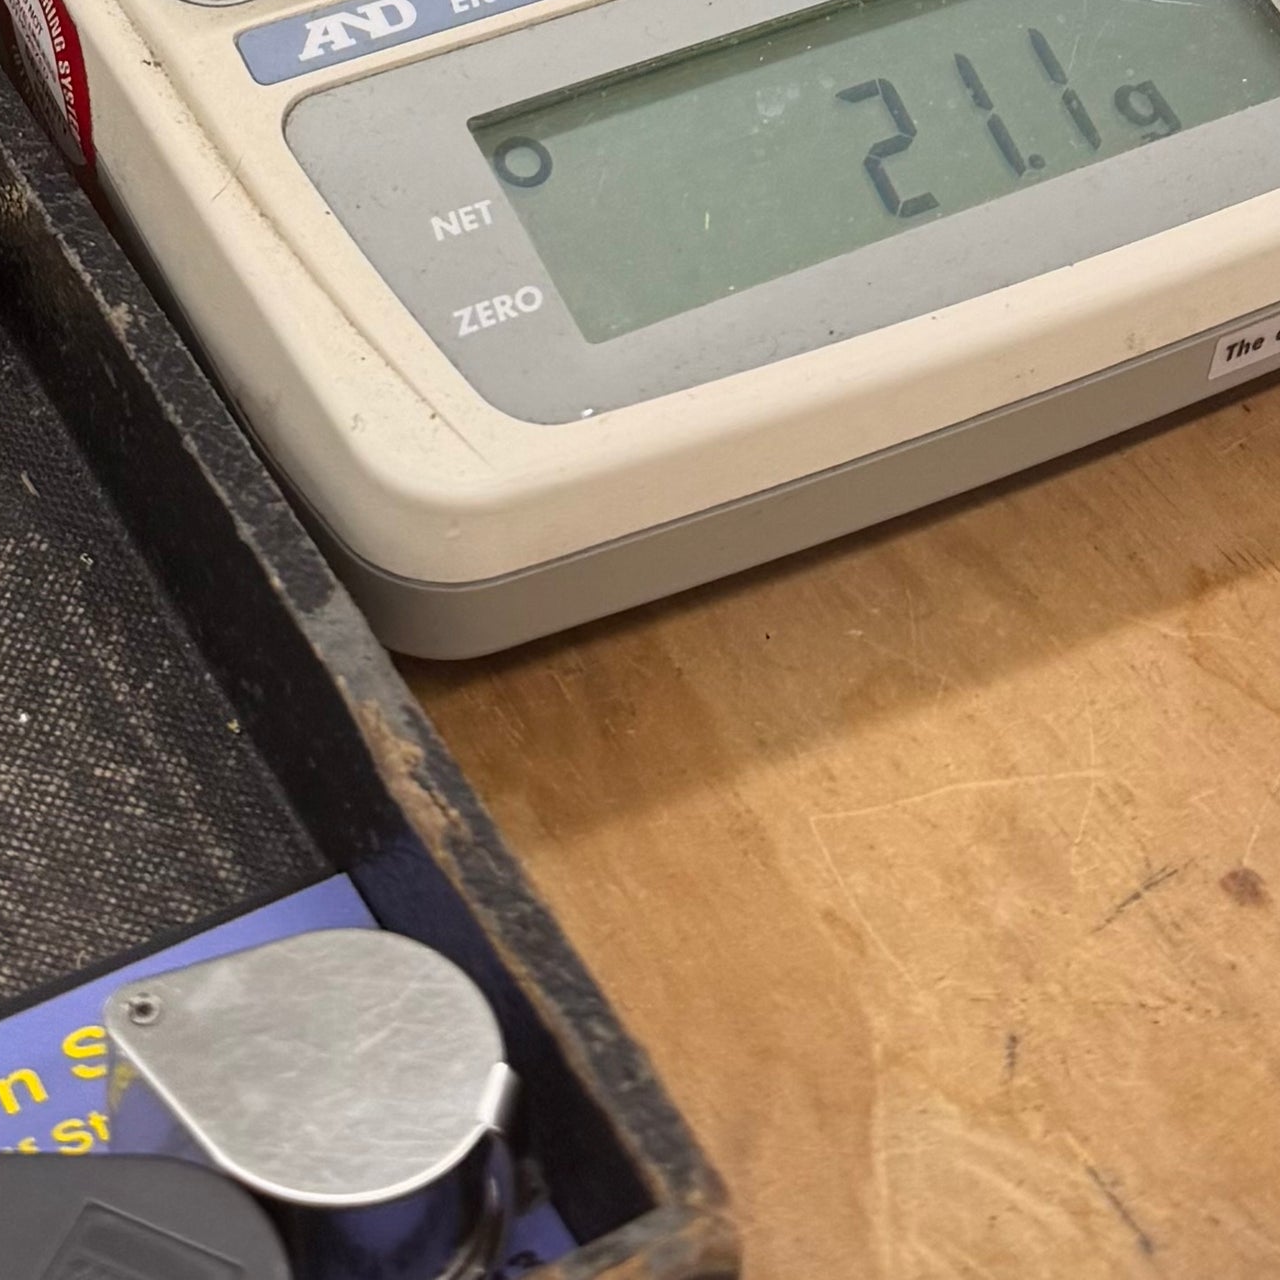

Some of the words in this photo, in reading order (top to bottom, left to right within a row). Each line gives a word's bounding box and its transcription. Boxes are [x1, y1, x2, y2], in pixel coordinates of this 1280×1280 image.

[429, 198, 495, 242] NET
[452, 284, 545, 339] ZERO
[1225, 336, 1265, 362] The
